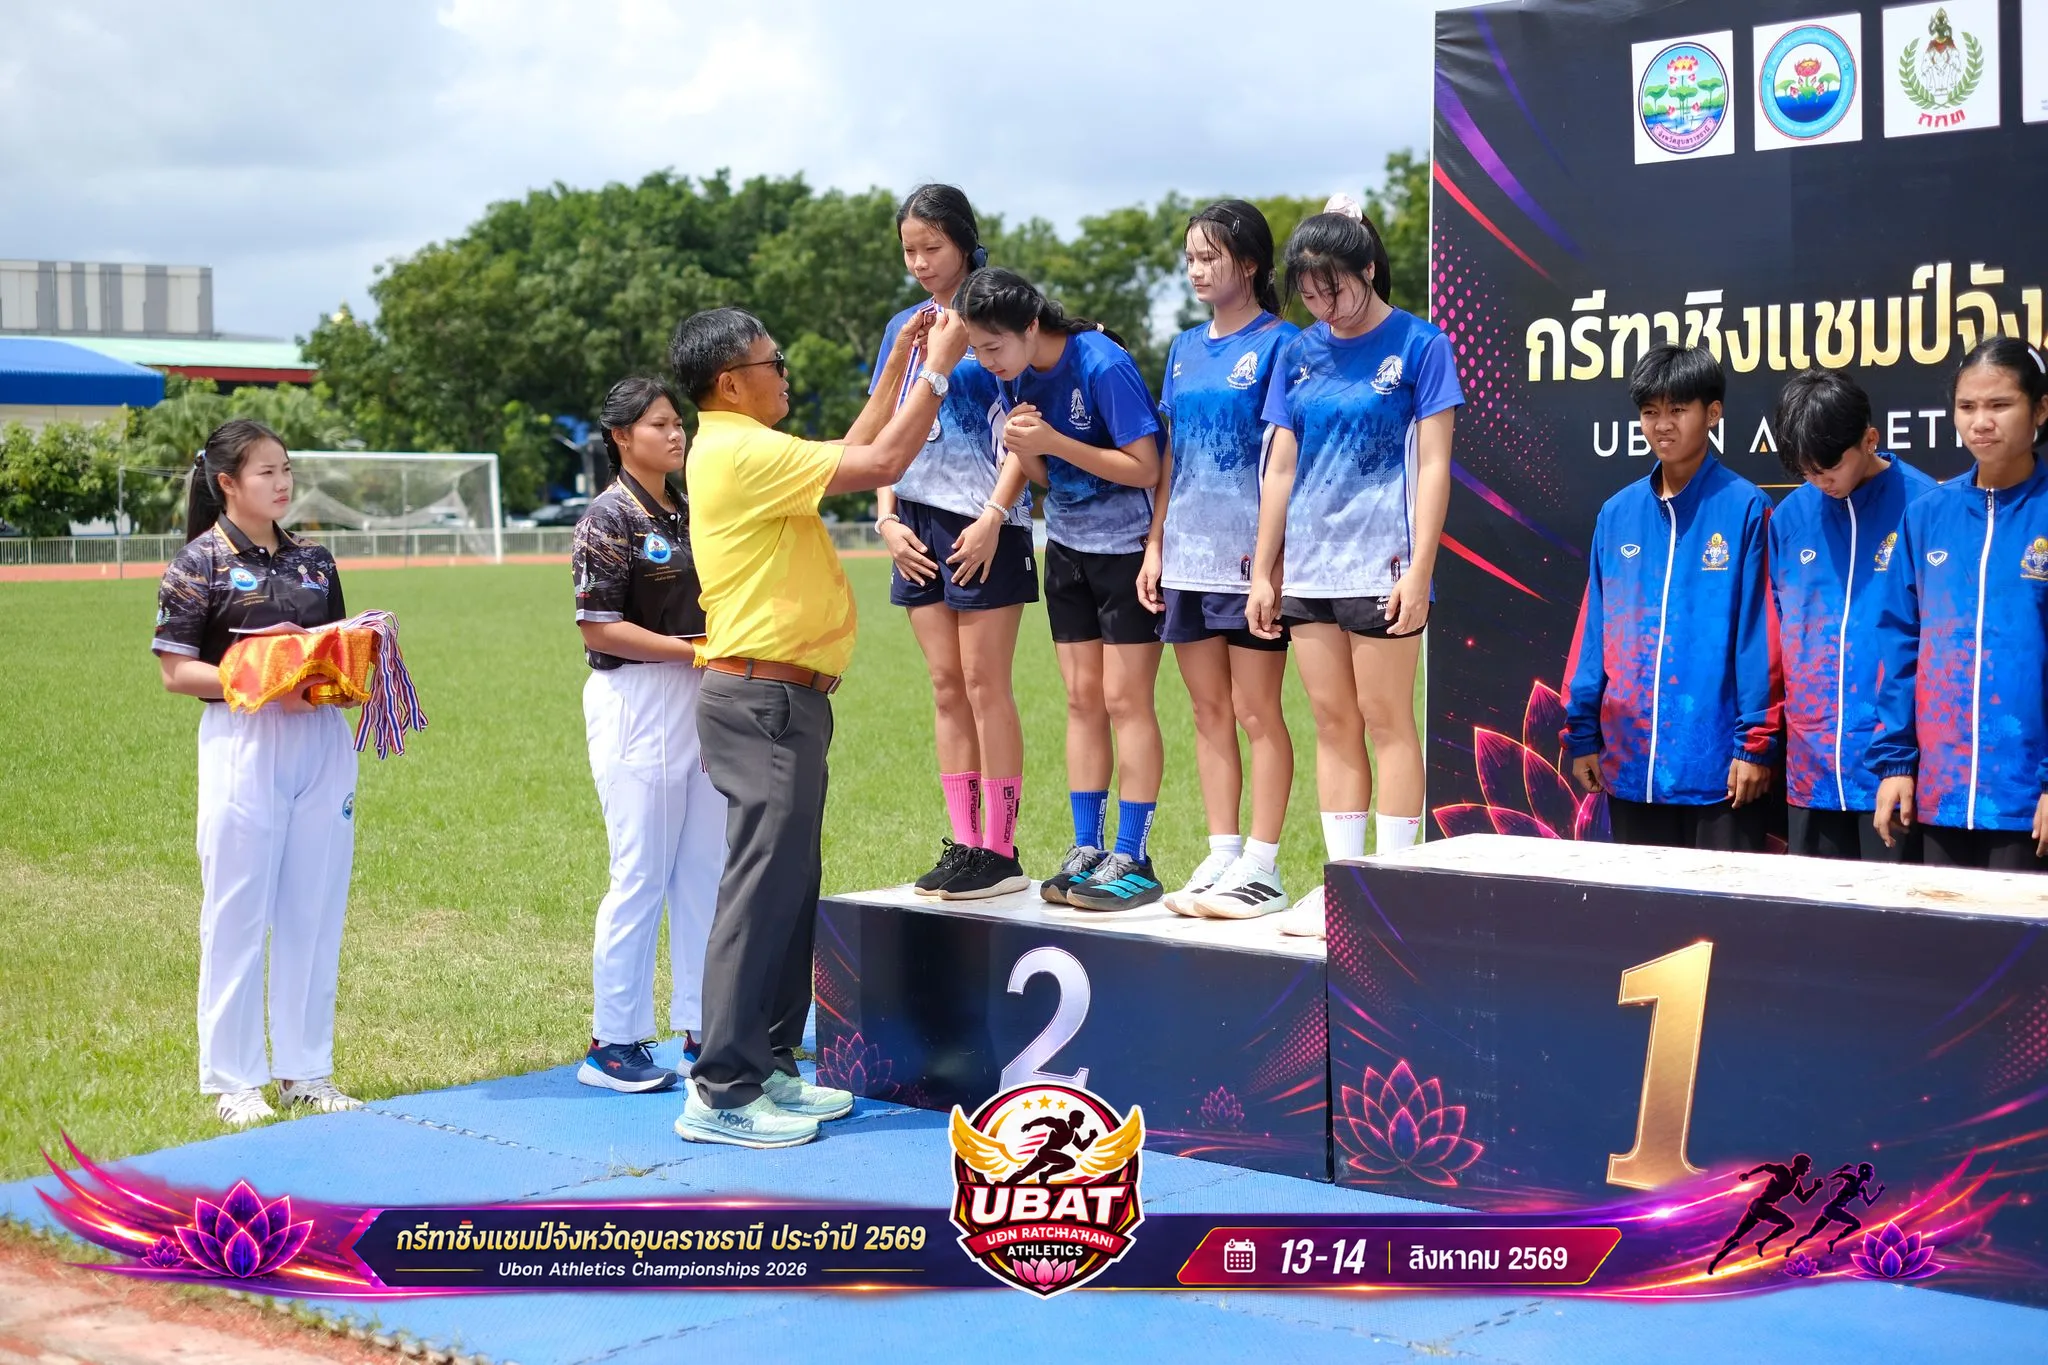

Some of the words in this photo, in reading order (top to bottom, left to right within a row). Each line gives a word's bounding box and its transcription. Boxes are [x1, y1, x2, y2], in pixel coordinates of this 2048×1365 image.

[1918, 109, 1966, 128] กกท
[1593, 417, 1726, 458] UBN
[1000, 946, 1091, 1091] 2
[1606, 941, 1713, 1190] 1
[717, 1110, 755, 1131] HOKA
